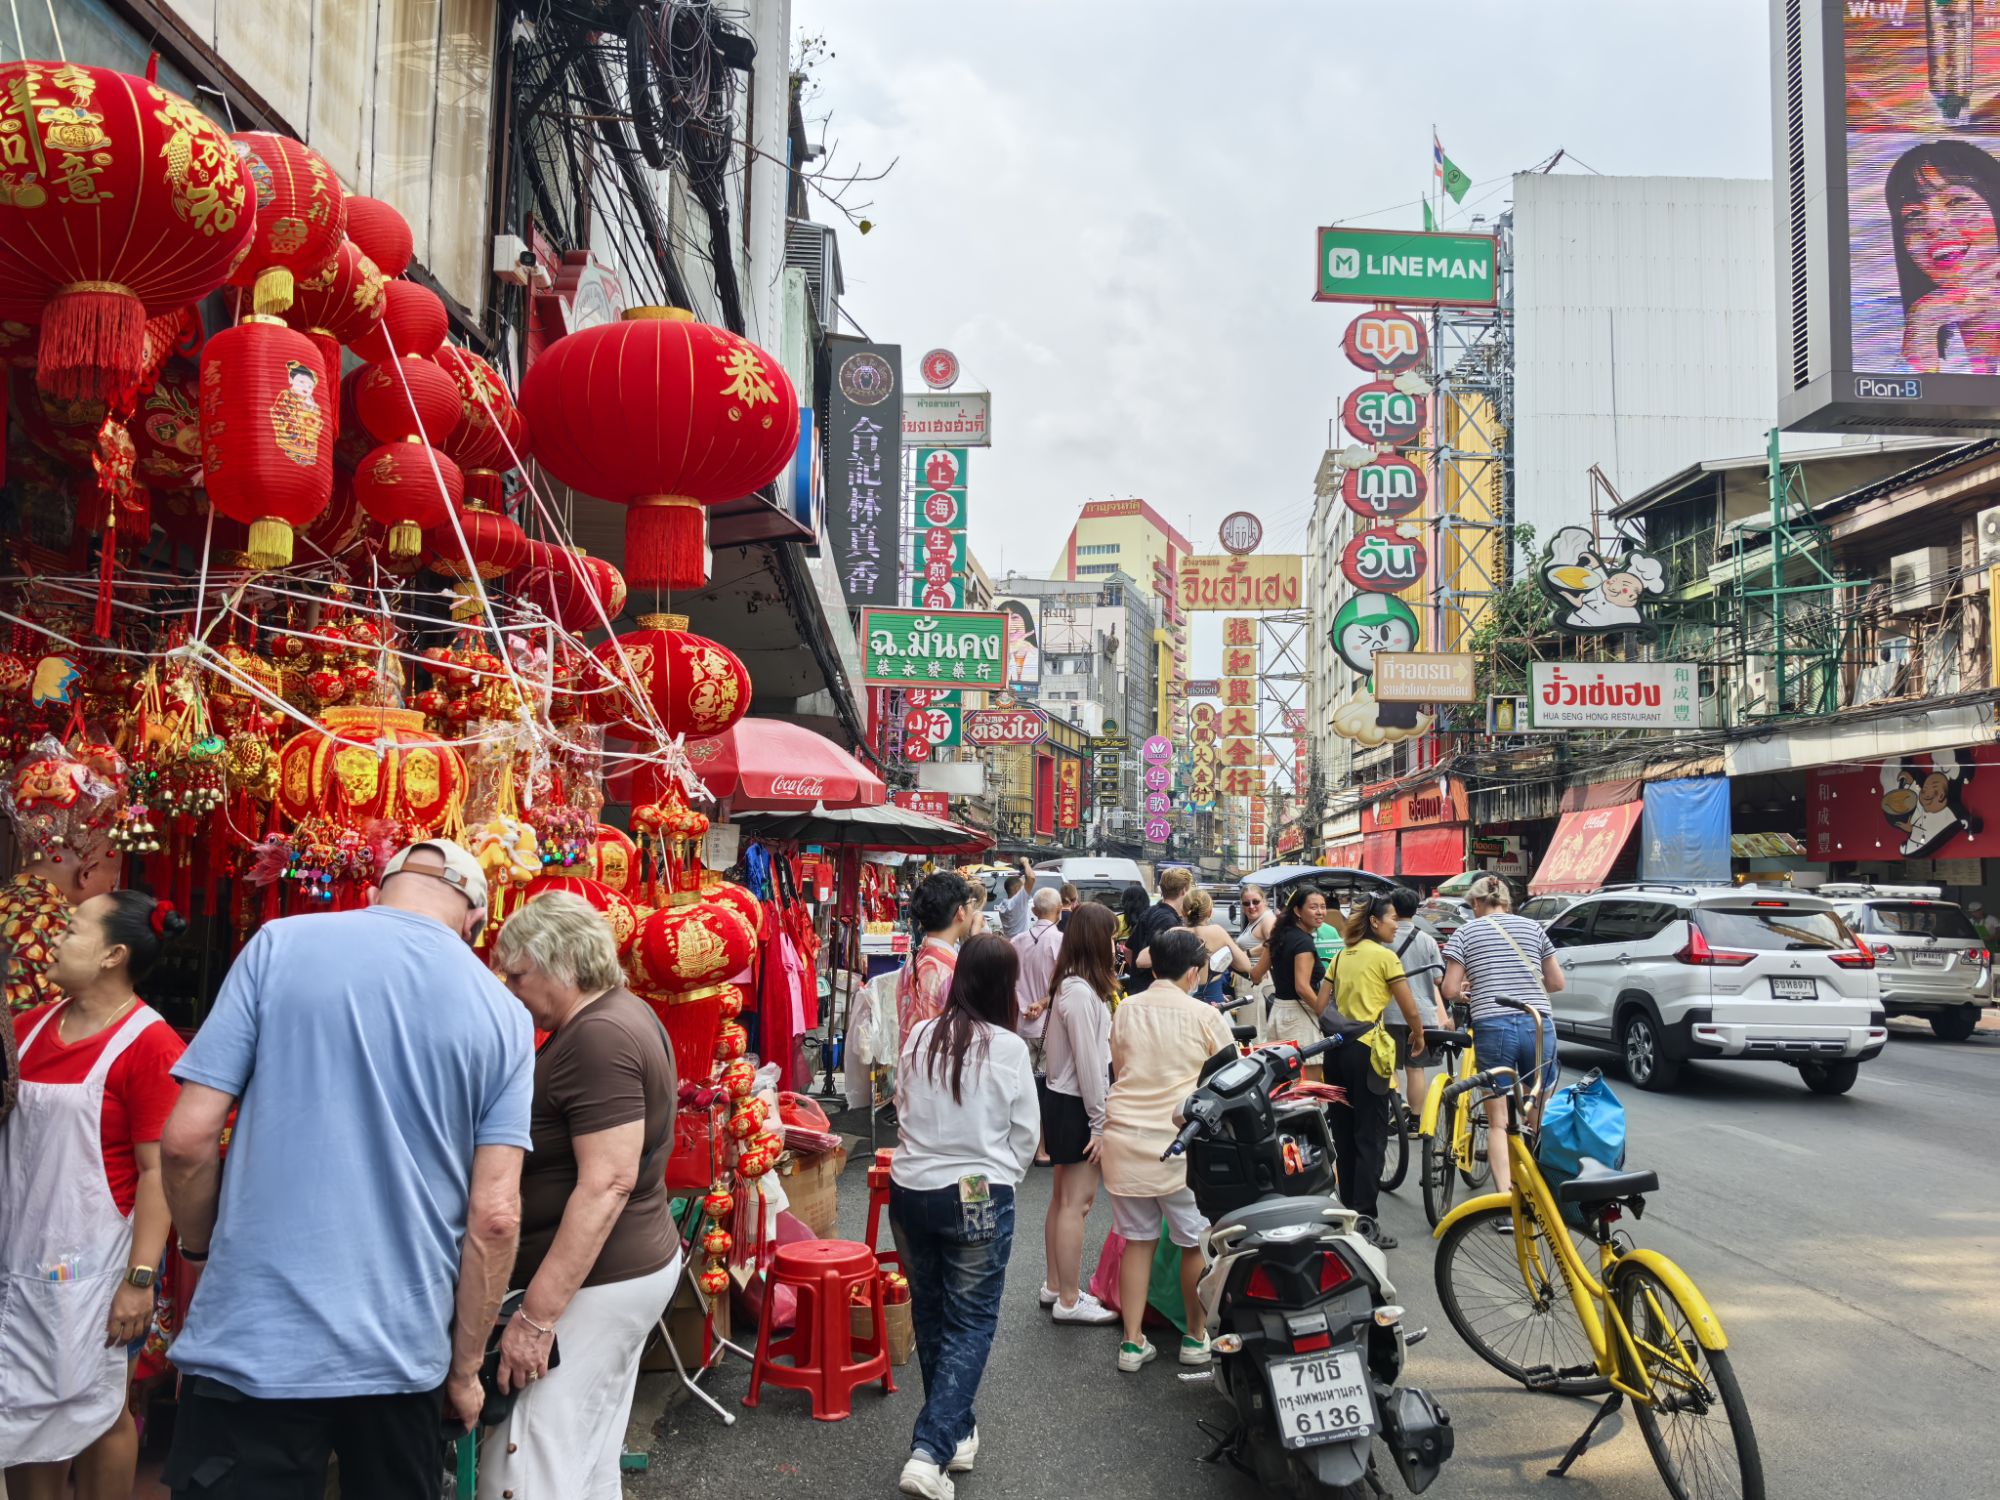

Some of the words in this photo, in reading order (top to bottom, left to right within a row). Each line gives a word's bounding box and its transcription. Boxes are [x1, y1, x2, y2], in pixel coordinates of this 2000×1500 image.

[1367, 254, 1423, 277] LINE
[1427, 257, 1487, 279] MAN
[1357, 393, 1416, 436] สุด
[1358, 466, 1416, 509] ทุก
[1357, 537, 1415, 577] วัน
[871, 616, 1000, 660] ฉ.มั่นคง
[1384, 656, 1451, 680] ที่จอดรถ
[1543, 667, 1661, 706] ฮั่วเซ่งฮง
[1543, 712, 1559, 721] HUA
[1562, 713, 1583, 721] SENG
[1586, 713, 1608, 721] HONG
[1611, 713, 1661, 721] RESTAURANT
[1150, 771, 1165, 838] 华歌尔
[1279, 1384, 1364, 1411] กรุงเทพมหานคร
[1296, 1404, 1361, 1433] 6136
